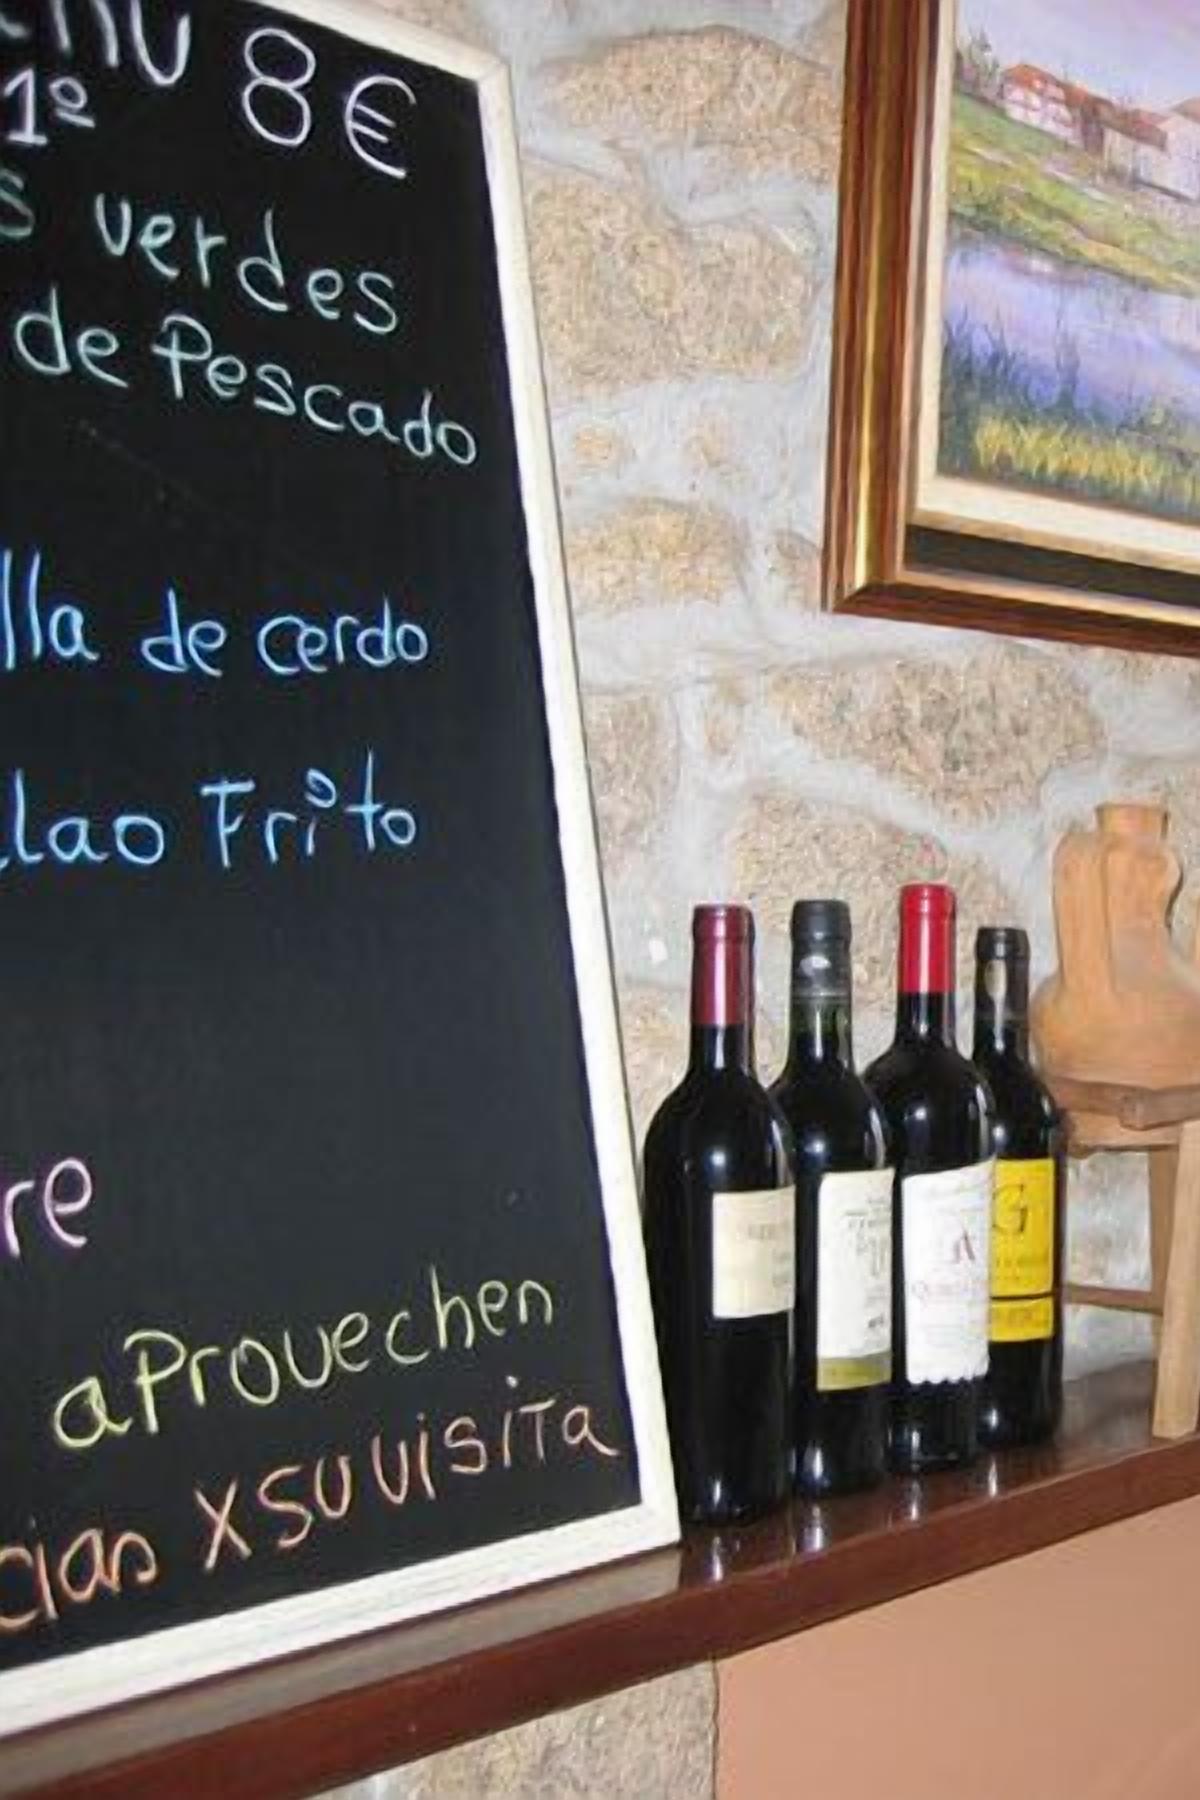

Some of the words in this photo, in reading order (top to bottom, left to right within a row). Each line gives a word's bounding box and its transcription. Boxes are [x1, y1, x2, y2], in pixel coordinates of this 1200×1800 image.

[242, 27, 316, 147] 8
[343, 74, 417, 179] €
[95, 193, 397, 333] verdes
[14, 285, 128, 388] de
[151, 314, 476, 464] Pescado
[140, 588, 226, 677] de
[257, 596, 428, 675] cerdo
[0, 768, 164, 868] lao
[201, 748, 416, 868] Frito
